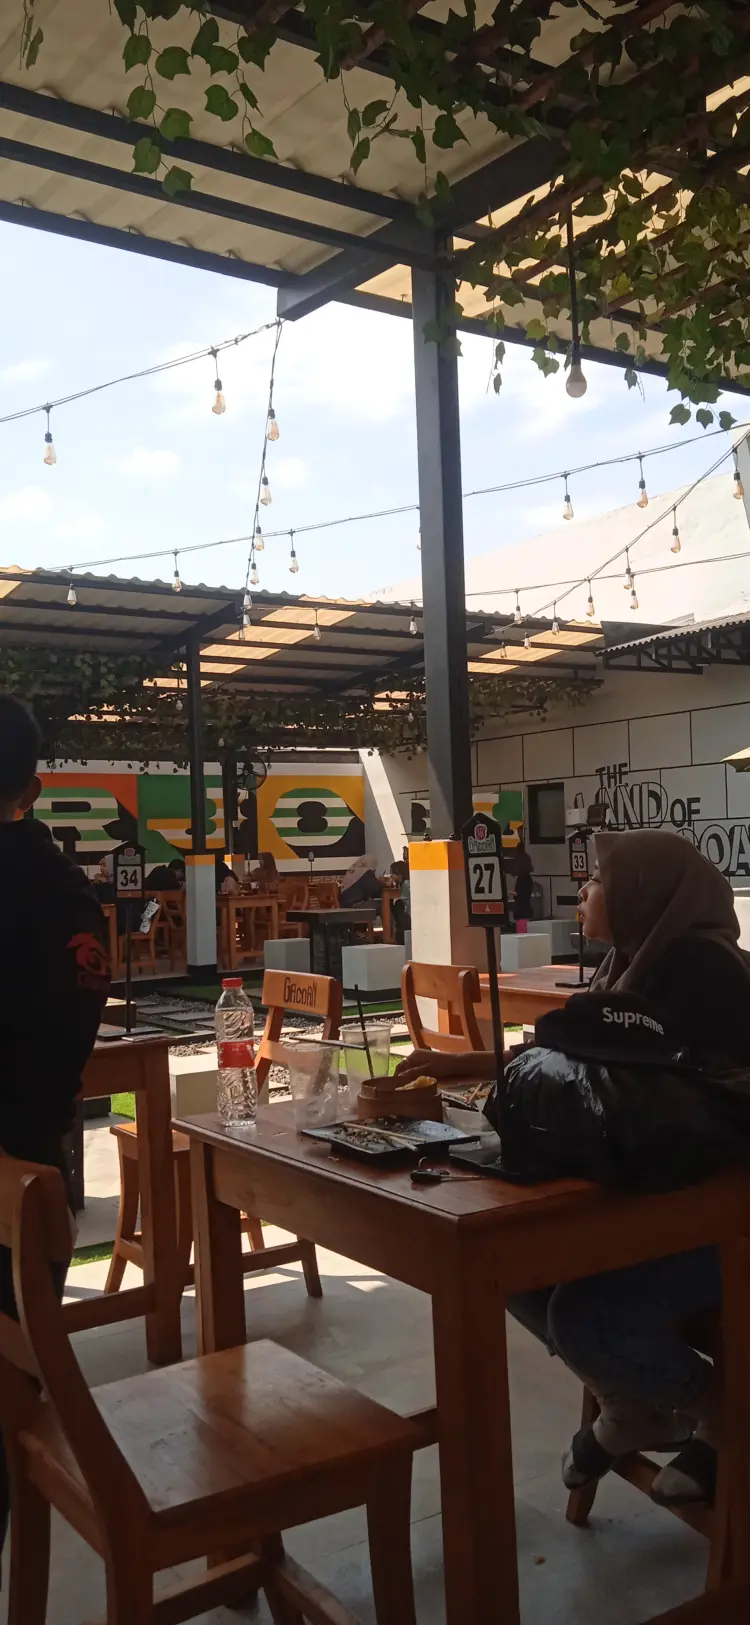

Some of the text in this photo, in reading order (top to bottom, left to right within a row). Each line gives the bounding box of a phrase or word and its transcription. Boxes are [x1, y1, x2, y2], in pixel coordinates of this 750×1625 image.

[596, 763, 629, 788] THE
[670, 797, 701, 828] OF
[574, 855, 584, 869] 33
[675, 824, 750, 875] OA
[120, 869, 138, 887] 34
[473, 863, 495, 894] 27
[602, 1006, 664, 1035] Supreme
